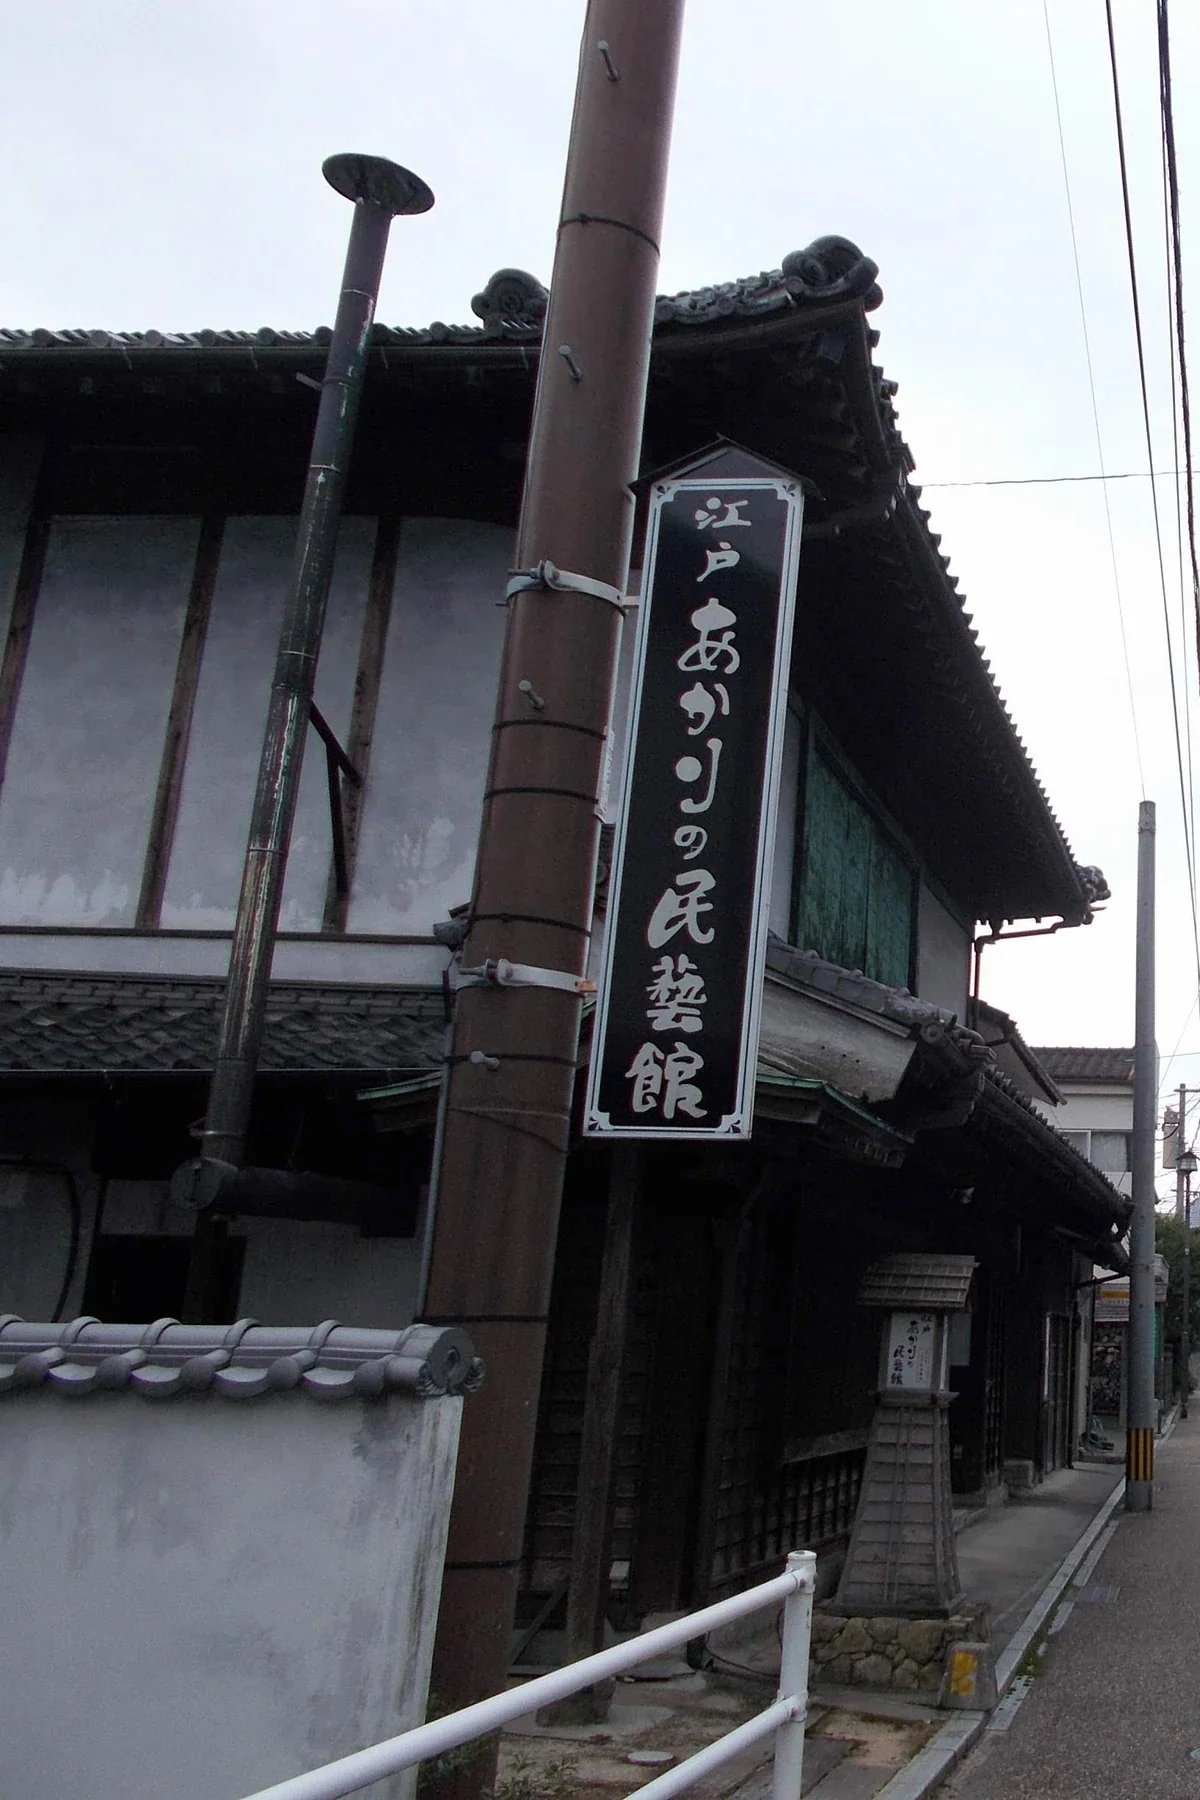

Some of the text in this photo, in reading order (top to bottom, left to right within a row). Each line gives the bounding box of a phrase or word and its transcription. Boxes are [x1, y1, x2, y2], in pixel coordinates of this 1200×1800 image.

[624, 496, 752, 1120] 江戸あかりの民藝館
